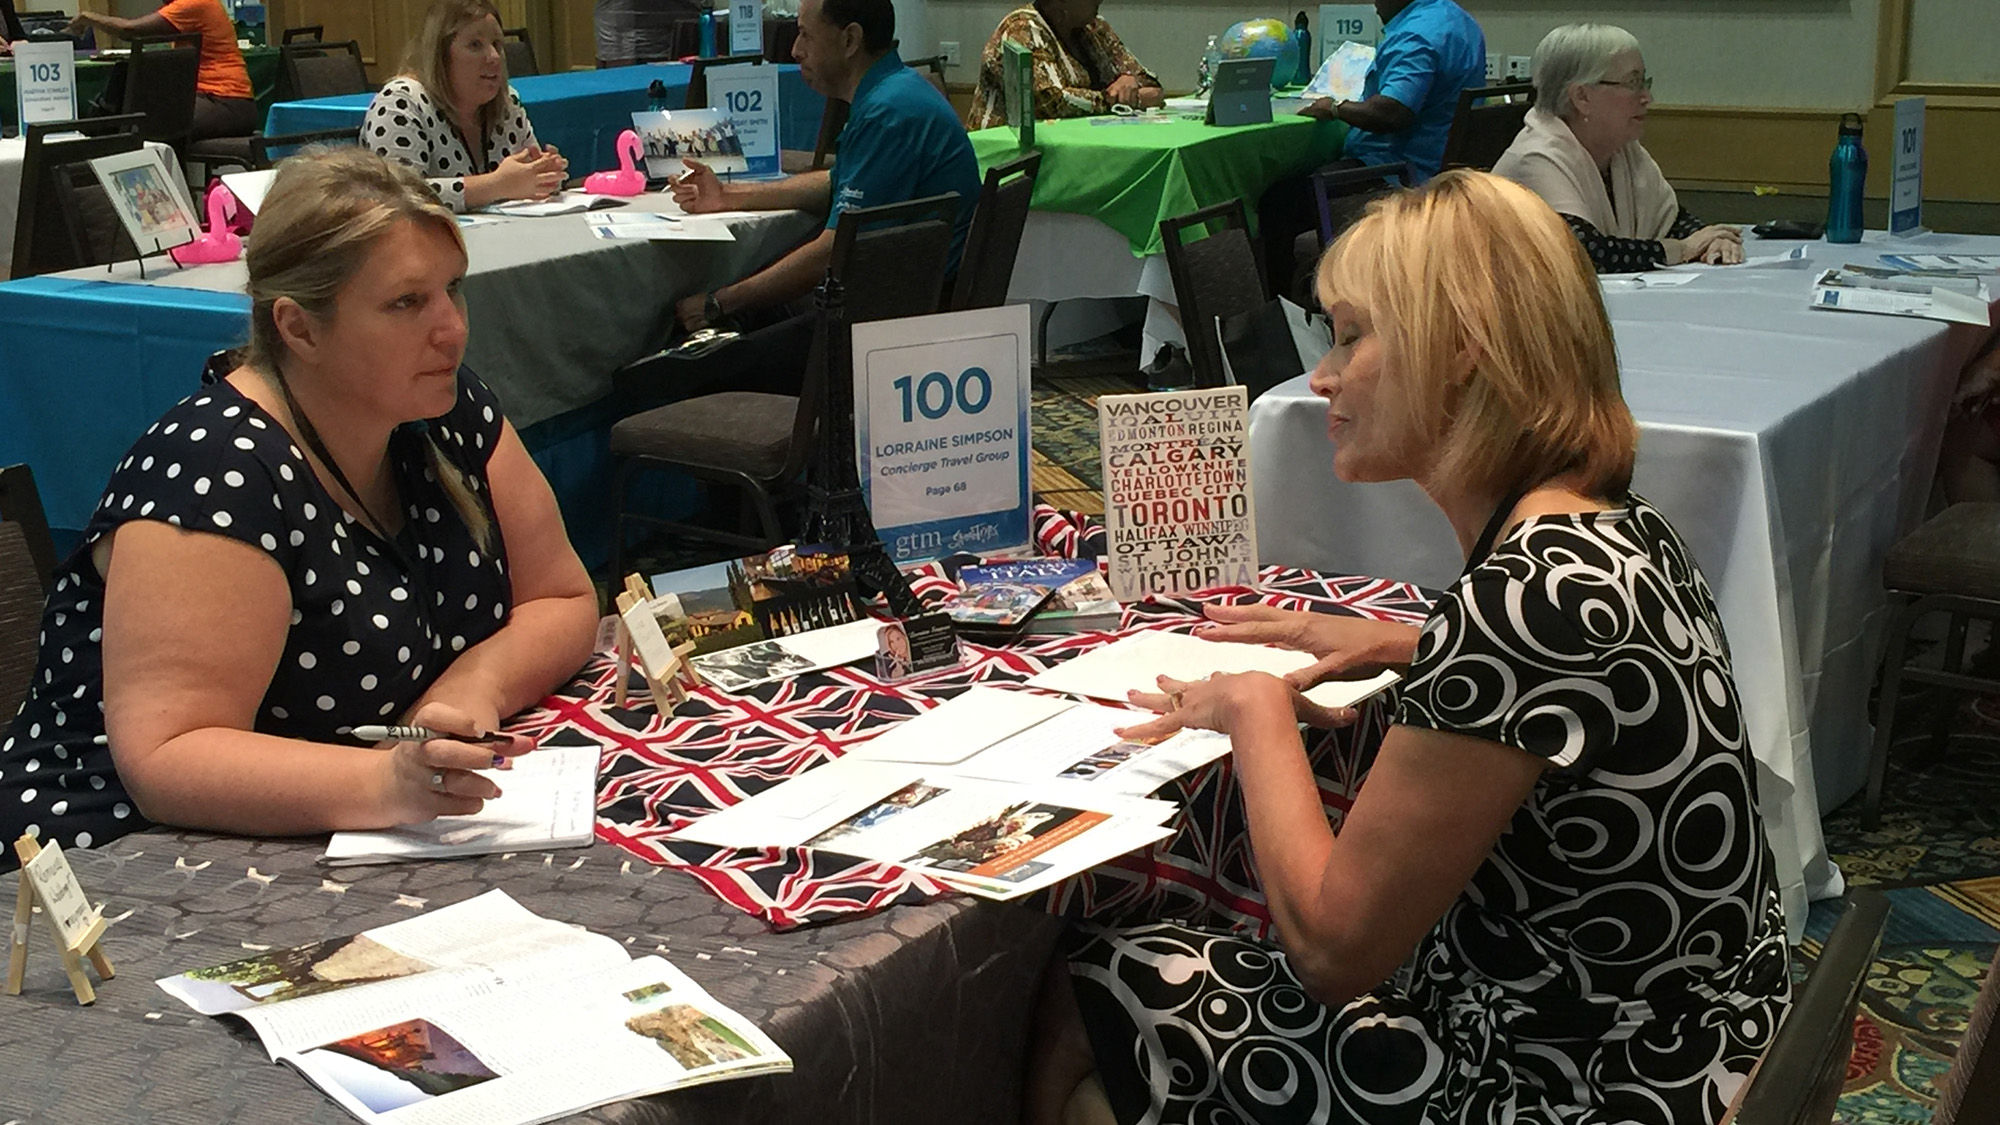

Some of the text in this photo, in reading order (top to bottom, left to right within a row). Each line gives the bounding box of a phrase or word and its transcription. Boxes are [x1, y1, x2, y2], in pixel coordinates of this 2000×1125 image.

[1336, 19, 1363, 35] 119
[30, 63, 60, 82] 103
[725, 90, 762, 113] 102
[1902, 127, 1916, 154] 101
[893, 366, 992, 423] 100
[1105, 394, 1241, 416] VANCOUVER
[1108, 408, 1242, 428] IQALUIT
[1108, 419, 1243, 441] EDMONTON REGINA
[876, 428, 1013, 458] LORRAINE SIMPSON
[881, 450, 1010, 476] Concierge Travel Group
[1109, 444, 1243, 468] CALGARY
[1111, 459, 1247, 478] YELLOWKNIFE
[926, 485, 951, 496] Page
[1111, 469, 1247, 492] CHARLOTTETOWN
[1112, 482, 1247, 503] QUEBEC CITY
[1113, 494, 1248, 528] TORONTO
[1115, 518, 1249, 543] HALIFAX WINNIPEG
[896, 531, 943, 558] gtm
[1116, 532, 1250, 554] OTTAWA
[1118, 564, 1252, 597] VICTORIA
